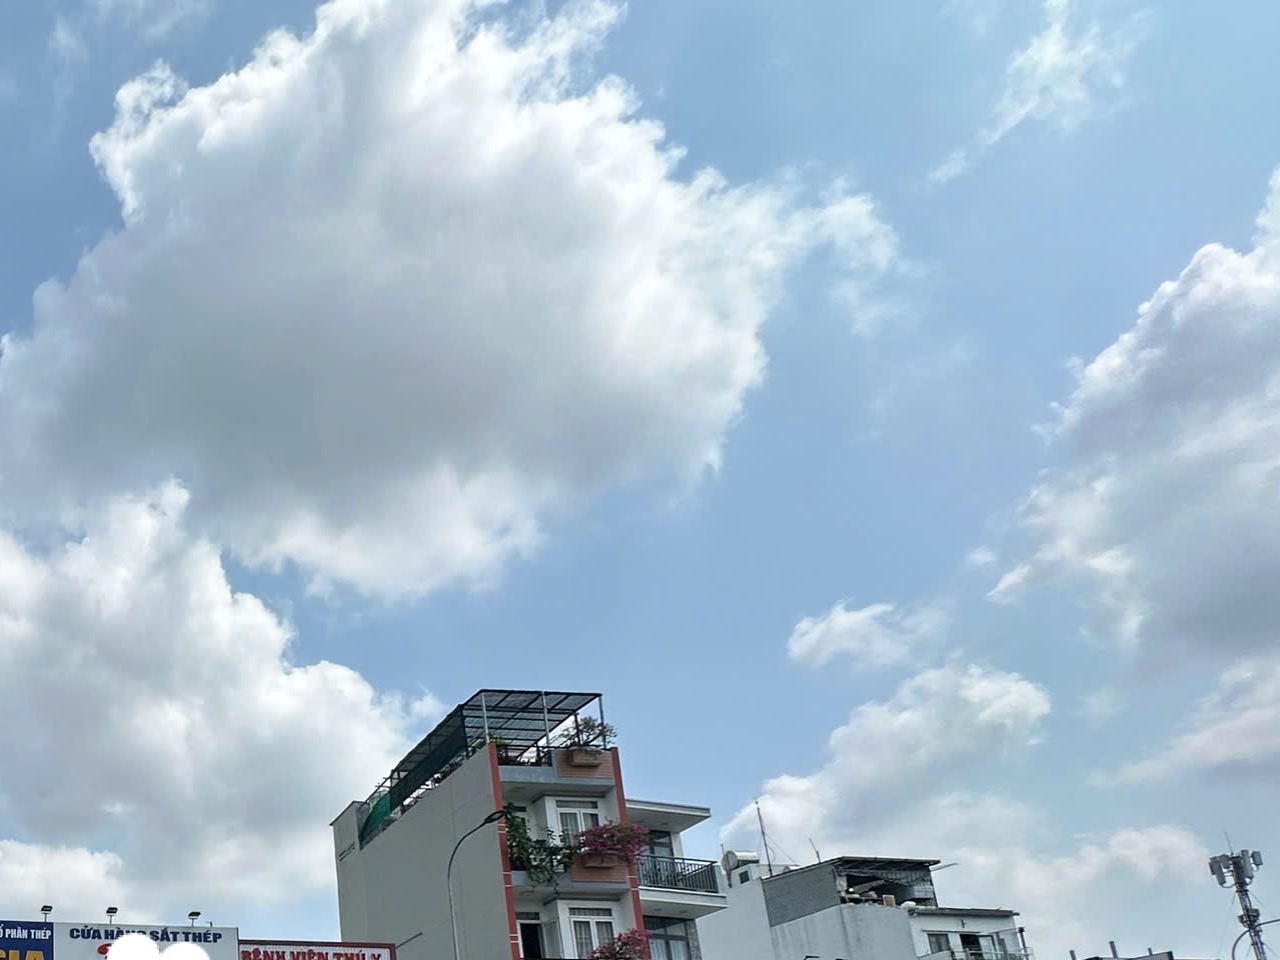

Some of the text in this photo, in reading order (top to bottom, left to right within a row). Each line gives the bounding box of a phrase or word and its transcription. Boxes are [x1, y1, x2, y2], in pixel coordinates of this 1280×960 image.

[30, 927, 52, 939] THÉP
[69, 925, 102, 940] CỬA
[182, 930, 222, 943] THÉP
